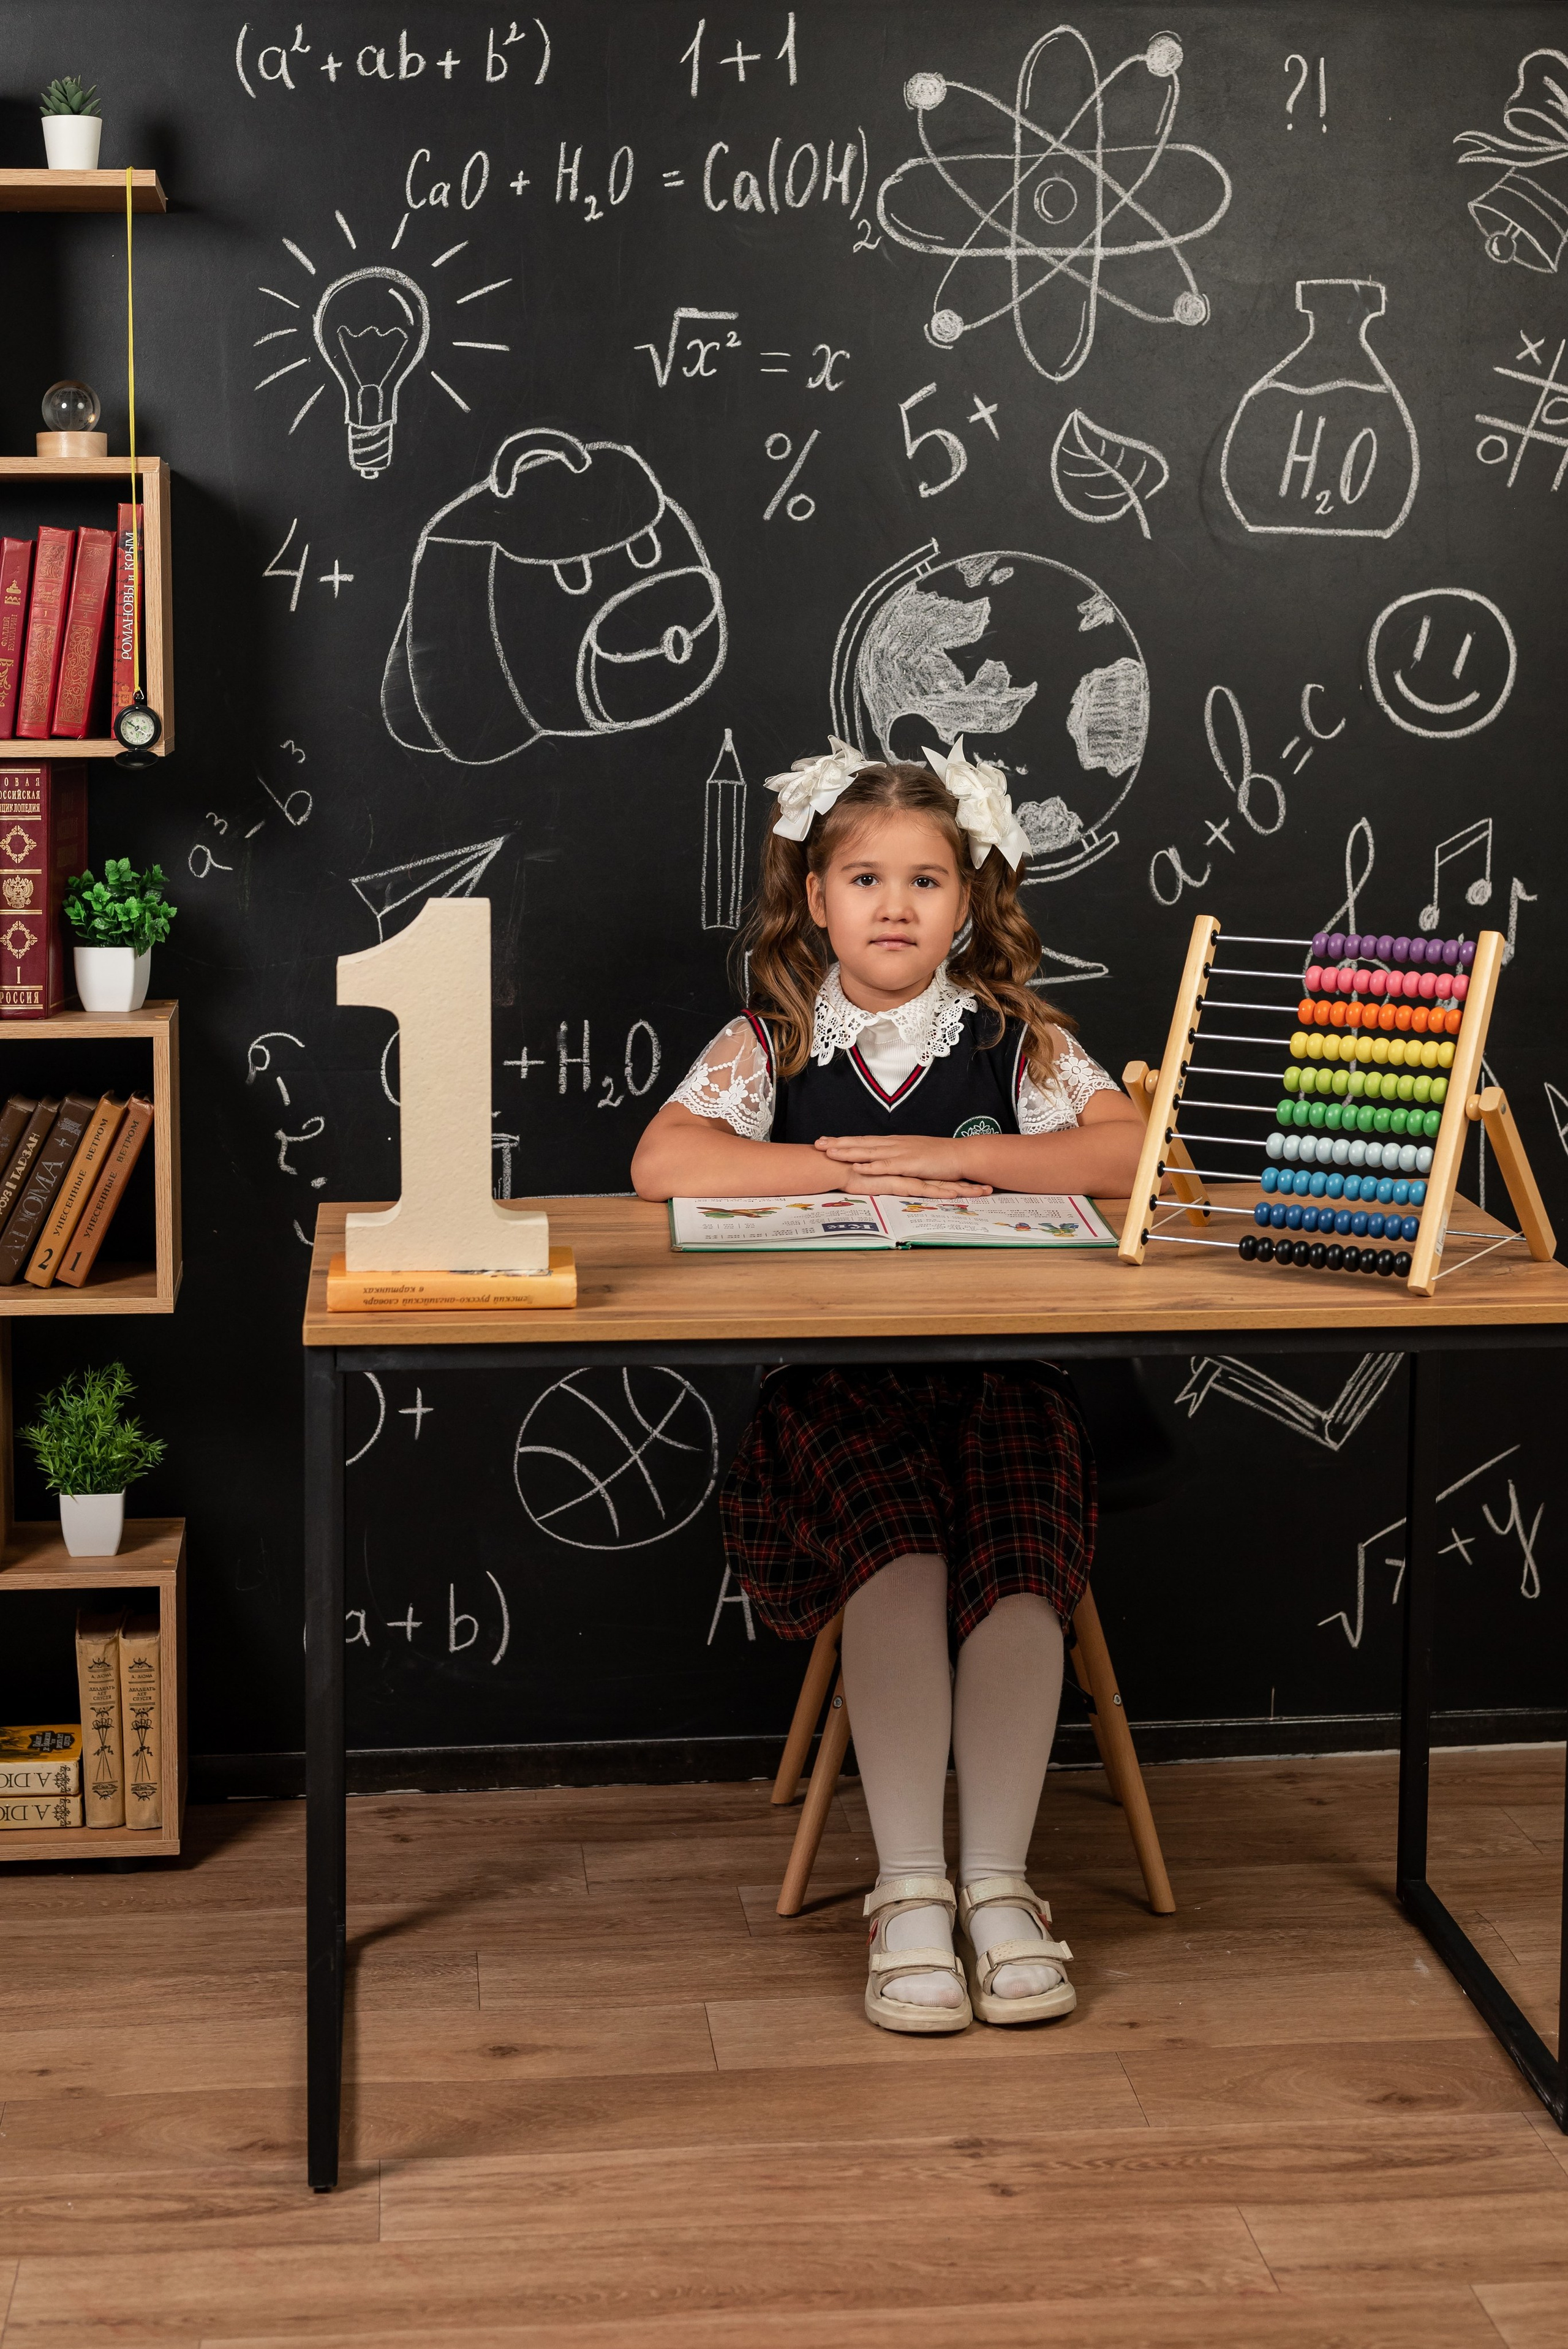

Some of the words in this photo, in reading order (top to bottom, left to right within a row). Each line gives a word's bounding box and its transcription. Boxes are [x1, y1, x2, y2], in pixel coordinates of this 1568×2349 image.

[764, 430, 821, 521] %
[122, 585, 134, 660] РОМАНОВЫ
[0, 991, 39, 1004] РОССИЯ
[336, 897, 549, 1272] 1
[53, 1169, 87, 1236] УНЕСЕННЫЕ
[86, 1118, 108, 1161] ВЕТРОМ
[83, 1171, 118, 1239] УНЕСЕННЫЕ
[116, 1120, 140, 1163] ВЕТРОМ
[38, 1248, 53, 1270] 2
[69, 1251, 82, 1272] 1
